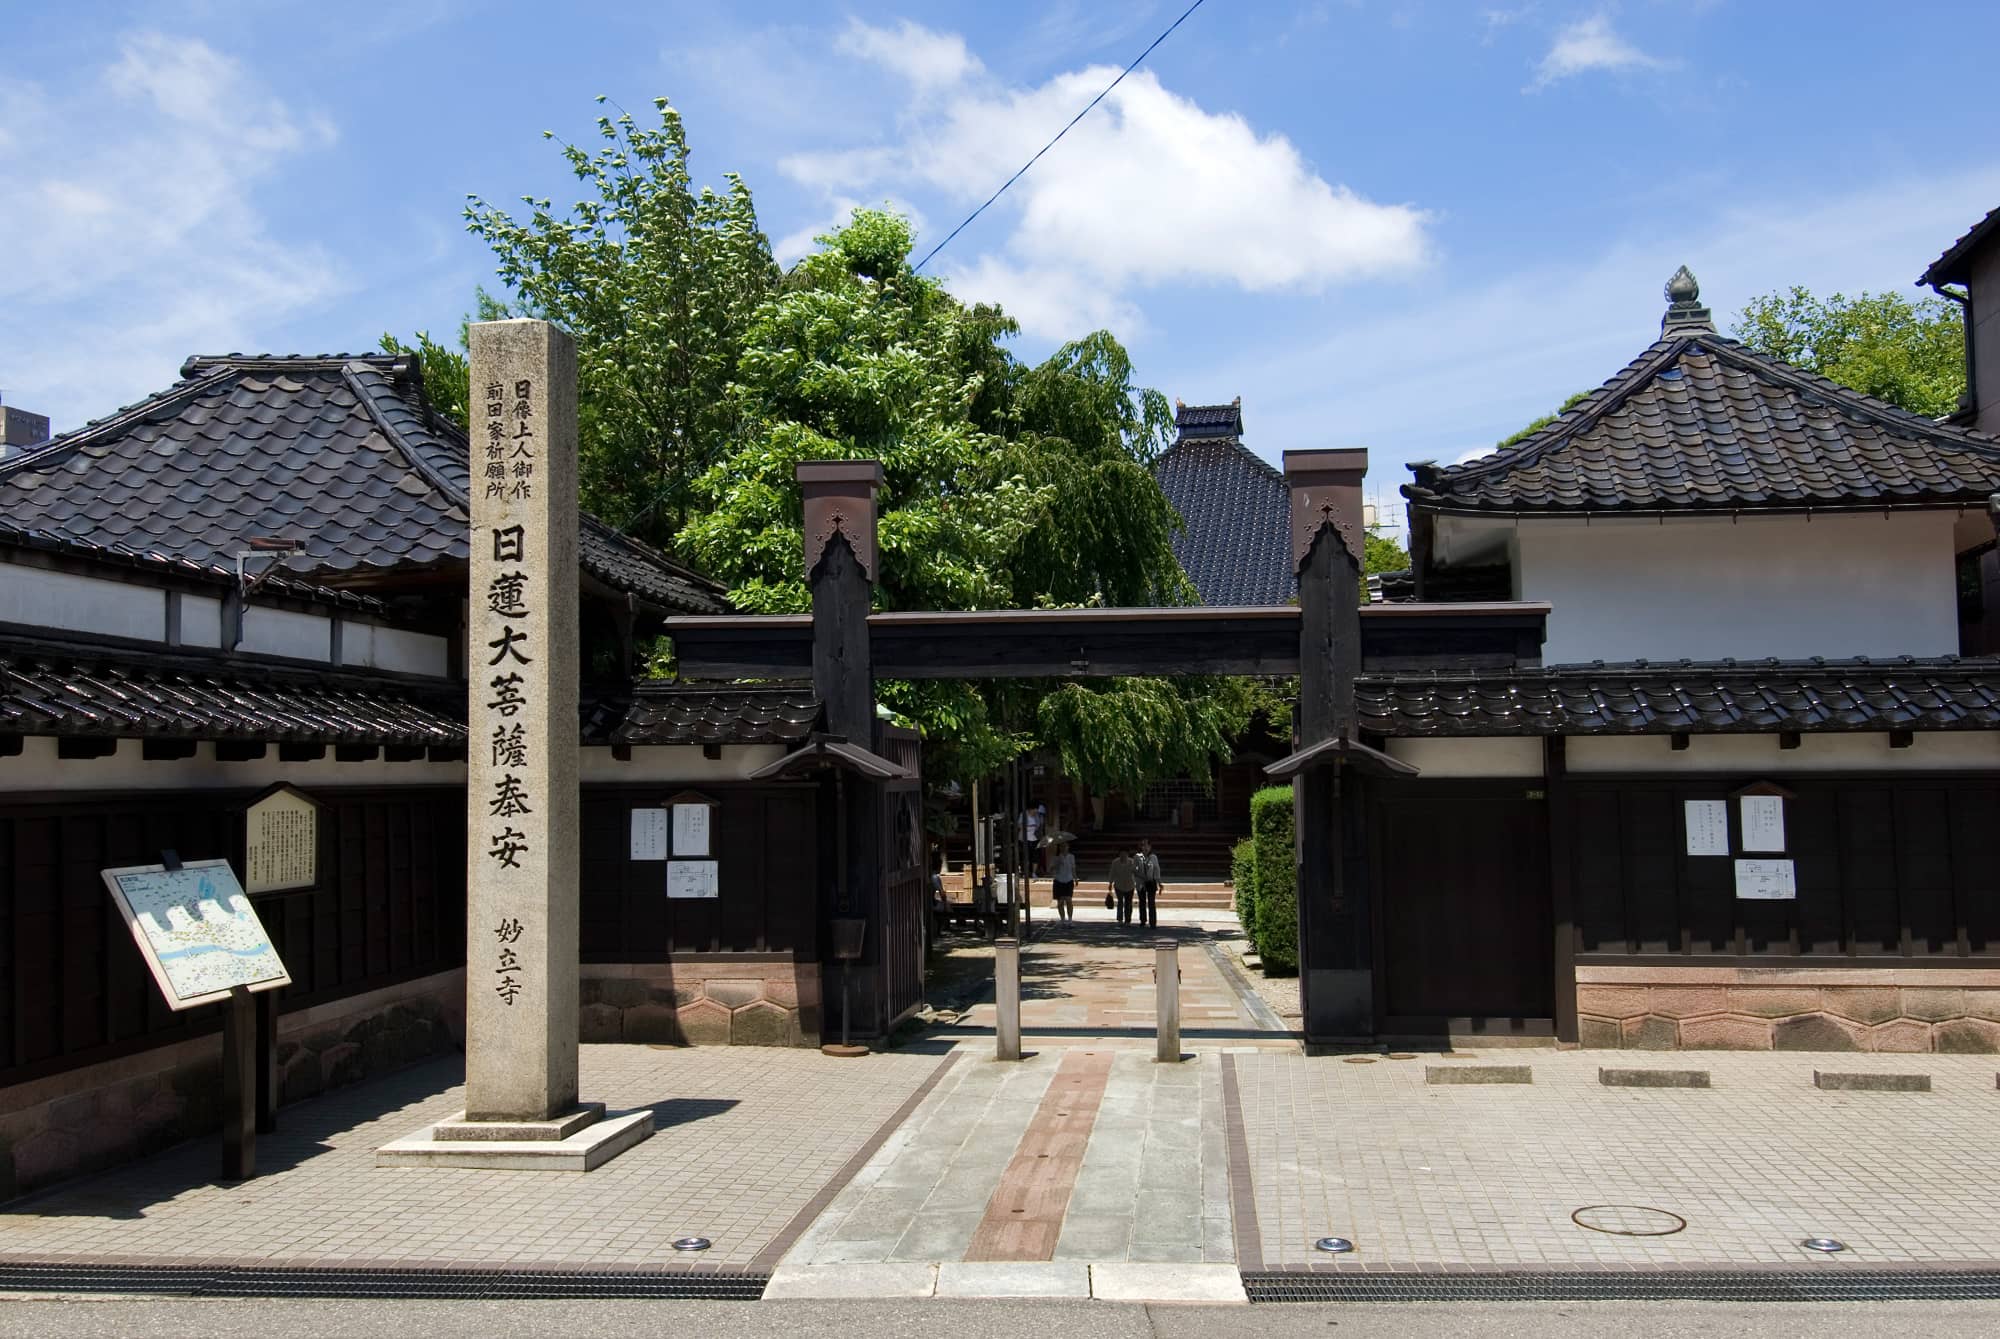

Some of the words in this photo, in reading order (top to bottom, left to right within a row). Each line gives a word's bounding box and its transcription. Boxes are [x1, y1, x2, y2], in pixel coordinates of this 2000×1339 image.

[484, 381, 506, 500] 前田家祈願所
[509, 379, 534, 500] 日像上人御作
[487, 524, 534, 869] 日蓮大菩薩奉安
[494, 918, 524, 1006] 妙立寺
